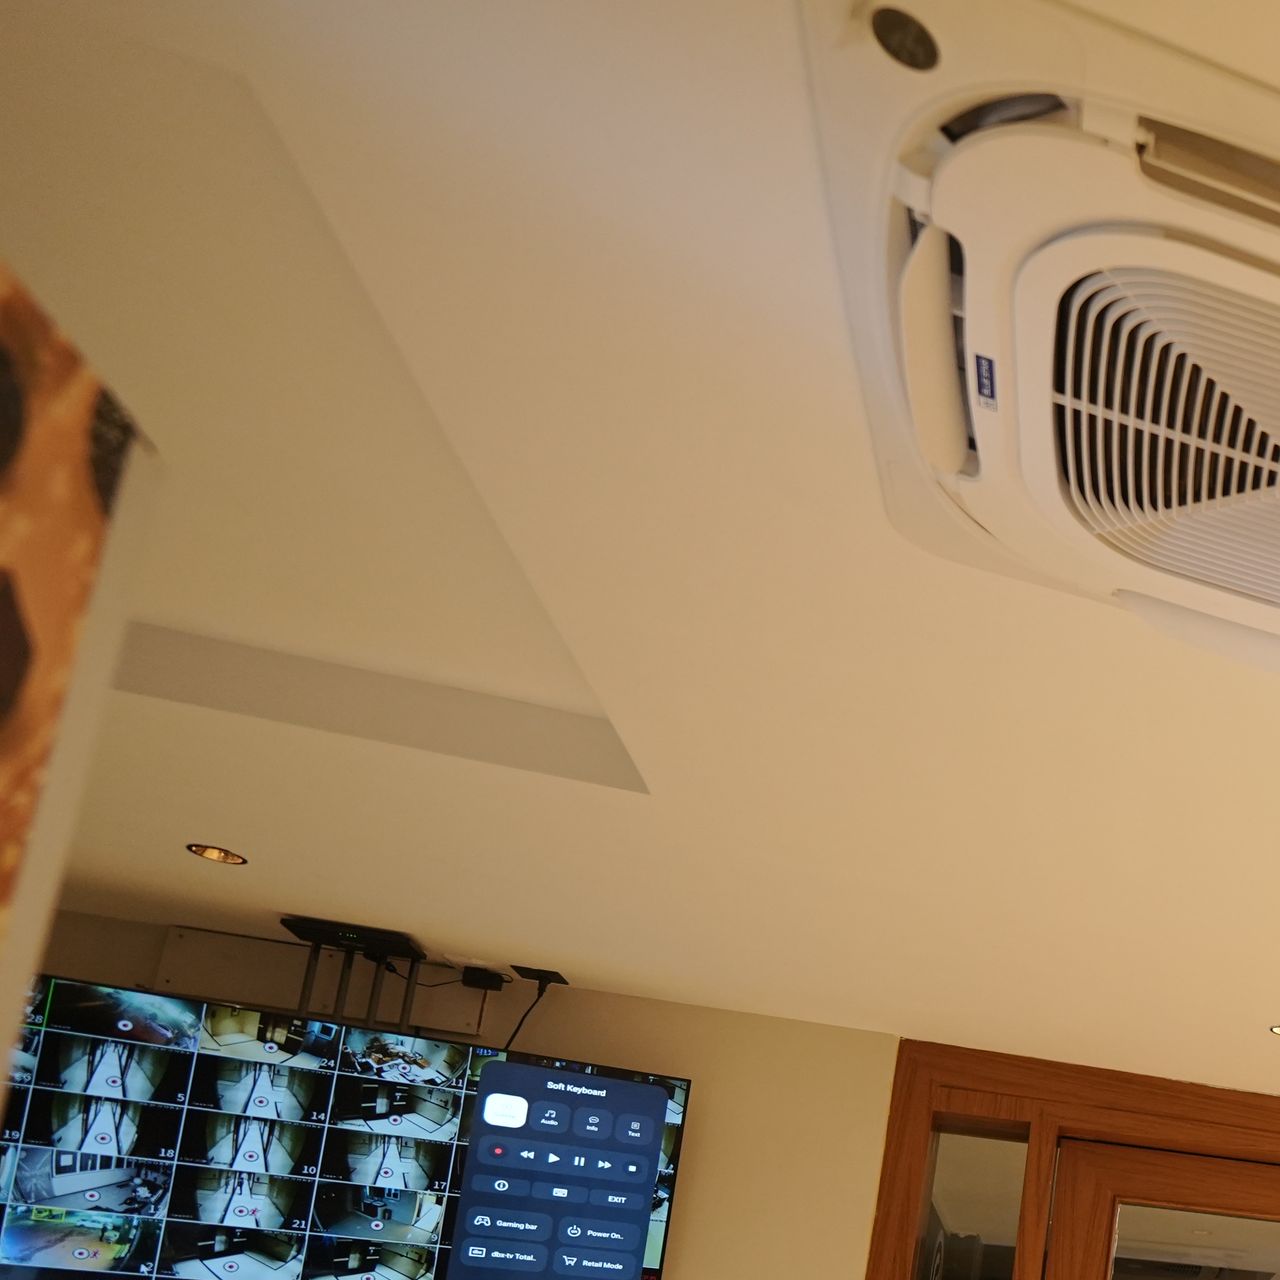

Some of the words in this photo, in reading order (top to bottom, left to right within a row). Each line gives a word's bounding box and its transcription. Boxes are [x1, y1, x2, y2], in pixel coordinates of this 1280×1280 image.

[320, 1058, 335, 1067] 24
[547, 1081, 565, 1091] Soft
[566, 1084, 607, 1098] Keyboard
[176, 1093, 185, 1102] 5
[311, 1111, 326, 1120] 14
[540, 1118, 558, 1126] Audio
[3, 1129, 20, 1140] 19
[628, 1130, 641, 1138] Text
[159, 1148, 175, 1158] 18
[302, 1165, 316, 1174] 10
[433, 1181, 447, 1189] 17
[608, 1195, 627, 1204] EXIT
[292, 1219, 306, 1228] 21
[496, 1219, 525, 1230] Gaming
[525, 1223, 538, 1231] bar
[587, 1229, 610, 1239] Power
[491, 1250, 514, 1260] dbx-tv
[582, 1259, 603, 1268] Retail
[603, 1262, 623, 1270] Mode
